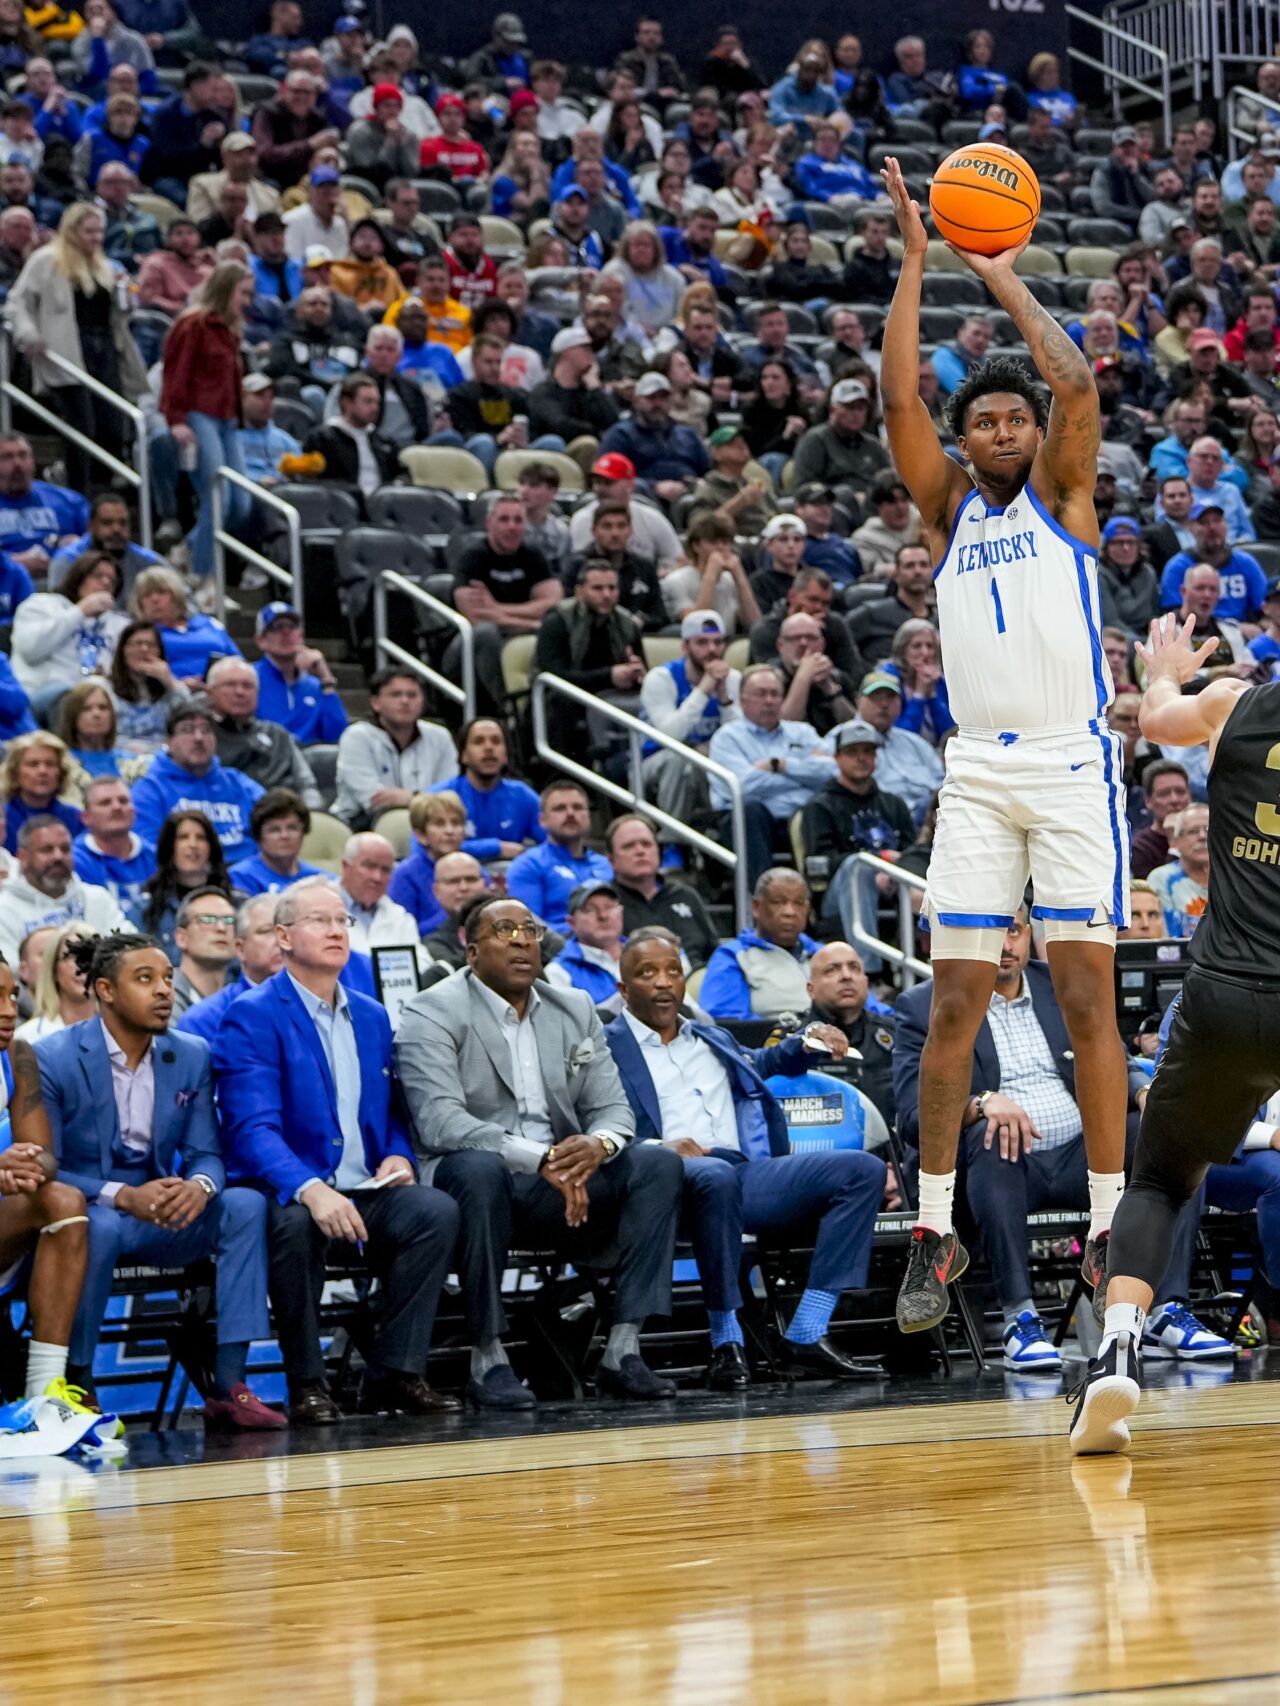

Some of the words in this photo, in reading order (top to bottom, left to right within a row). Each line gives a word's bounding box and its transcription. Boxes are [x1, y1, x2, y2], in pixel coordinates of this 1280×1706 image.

[949, 158, 1019, 192] Wilson
[957, 531, 1038, 576] KENUCKY
[991, 577, 1006, 634] 1
[783, 1098, 824, 1111] MARCH
[790, 1107, 844, 1123] MADNESS
[1047, 1213, 1061, 1223] THE
[1060, 1212, 1081, 1222] FINAL
[1080, 1212, 1092, 1222] FO
[880, 1221, 902, 1232] FINAL
